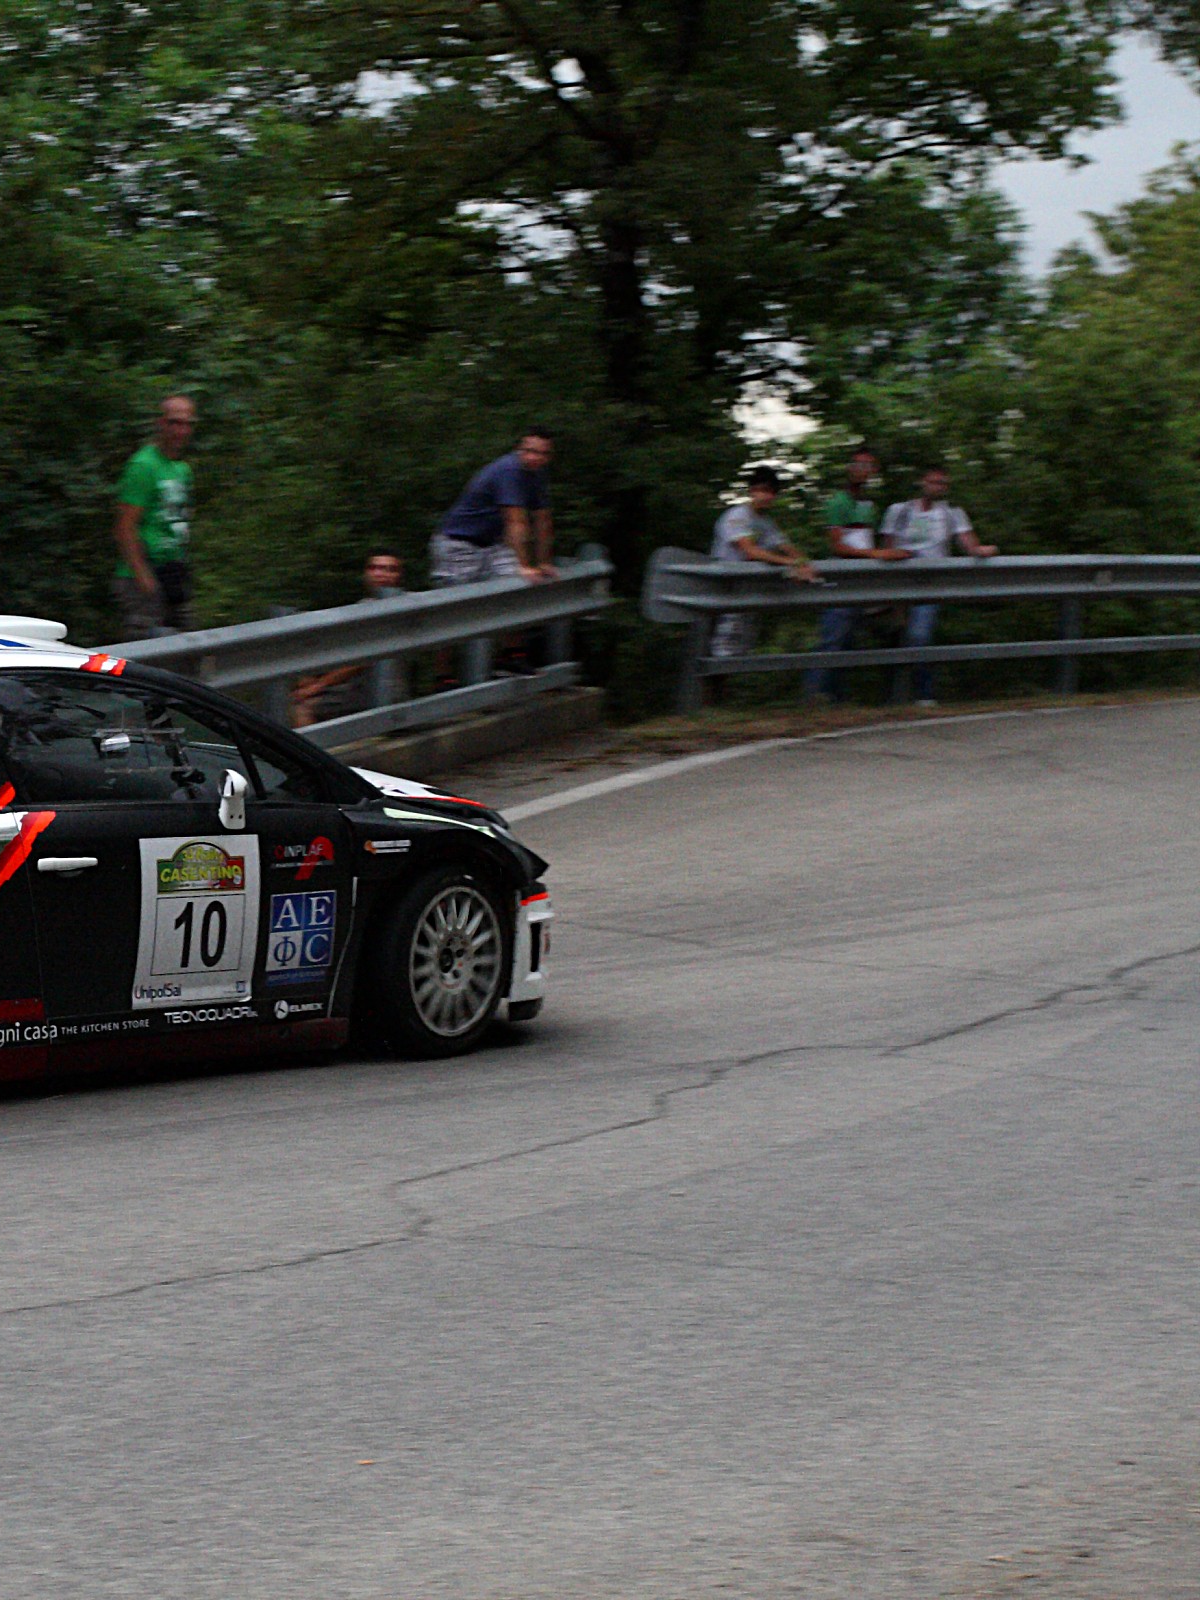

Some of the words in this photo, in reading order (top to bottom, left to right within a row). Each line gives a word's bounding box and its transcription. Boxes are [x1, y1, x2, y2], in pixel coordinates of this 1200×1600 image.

[174, 900, 227, 968] 10
[23, 1024, 58, 1040] casa
[61, 1025, 78, 1035] THE
[81, 1022, 120, 1033] KITCHEN
[122, 1018, 150, 1030] STORE
